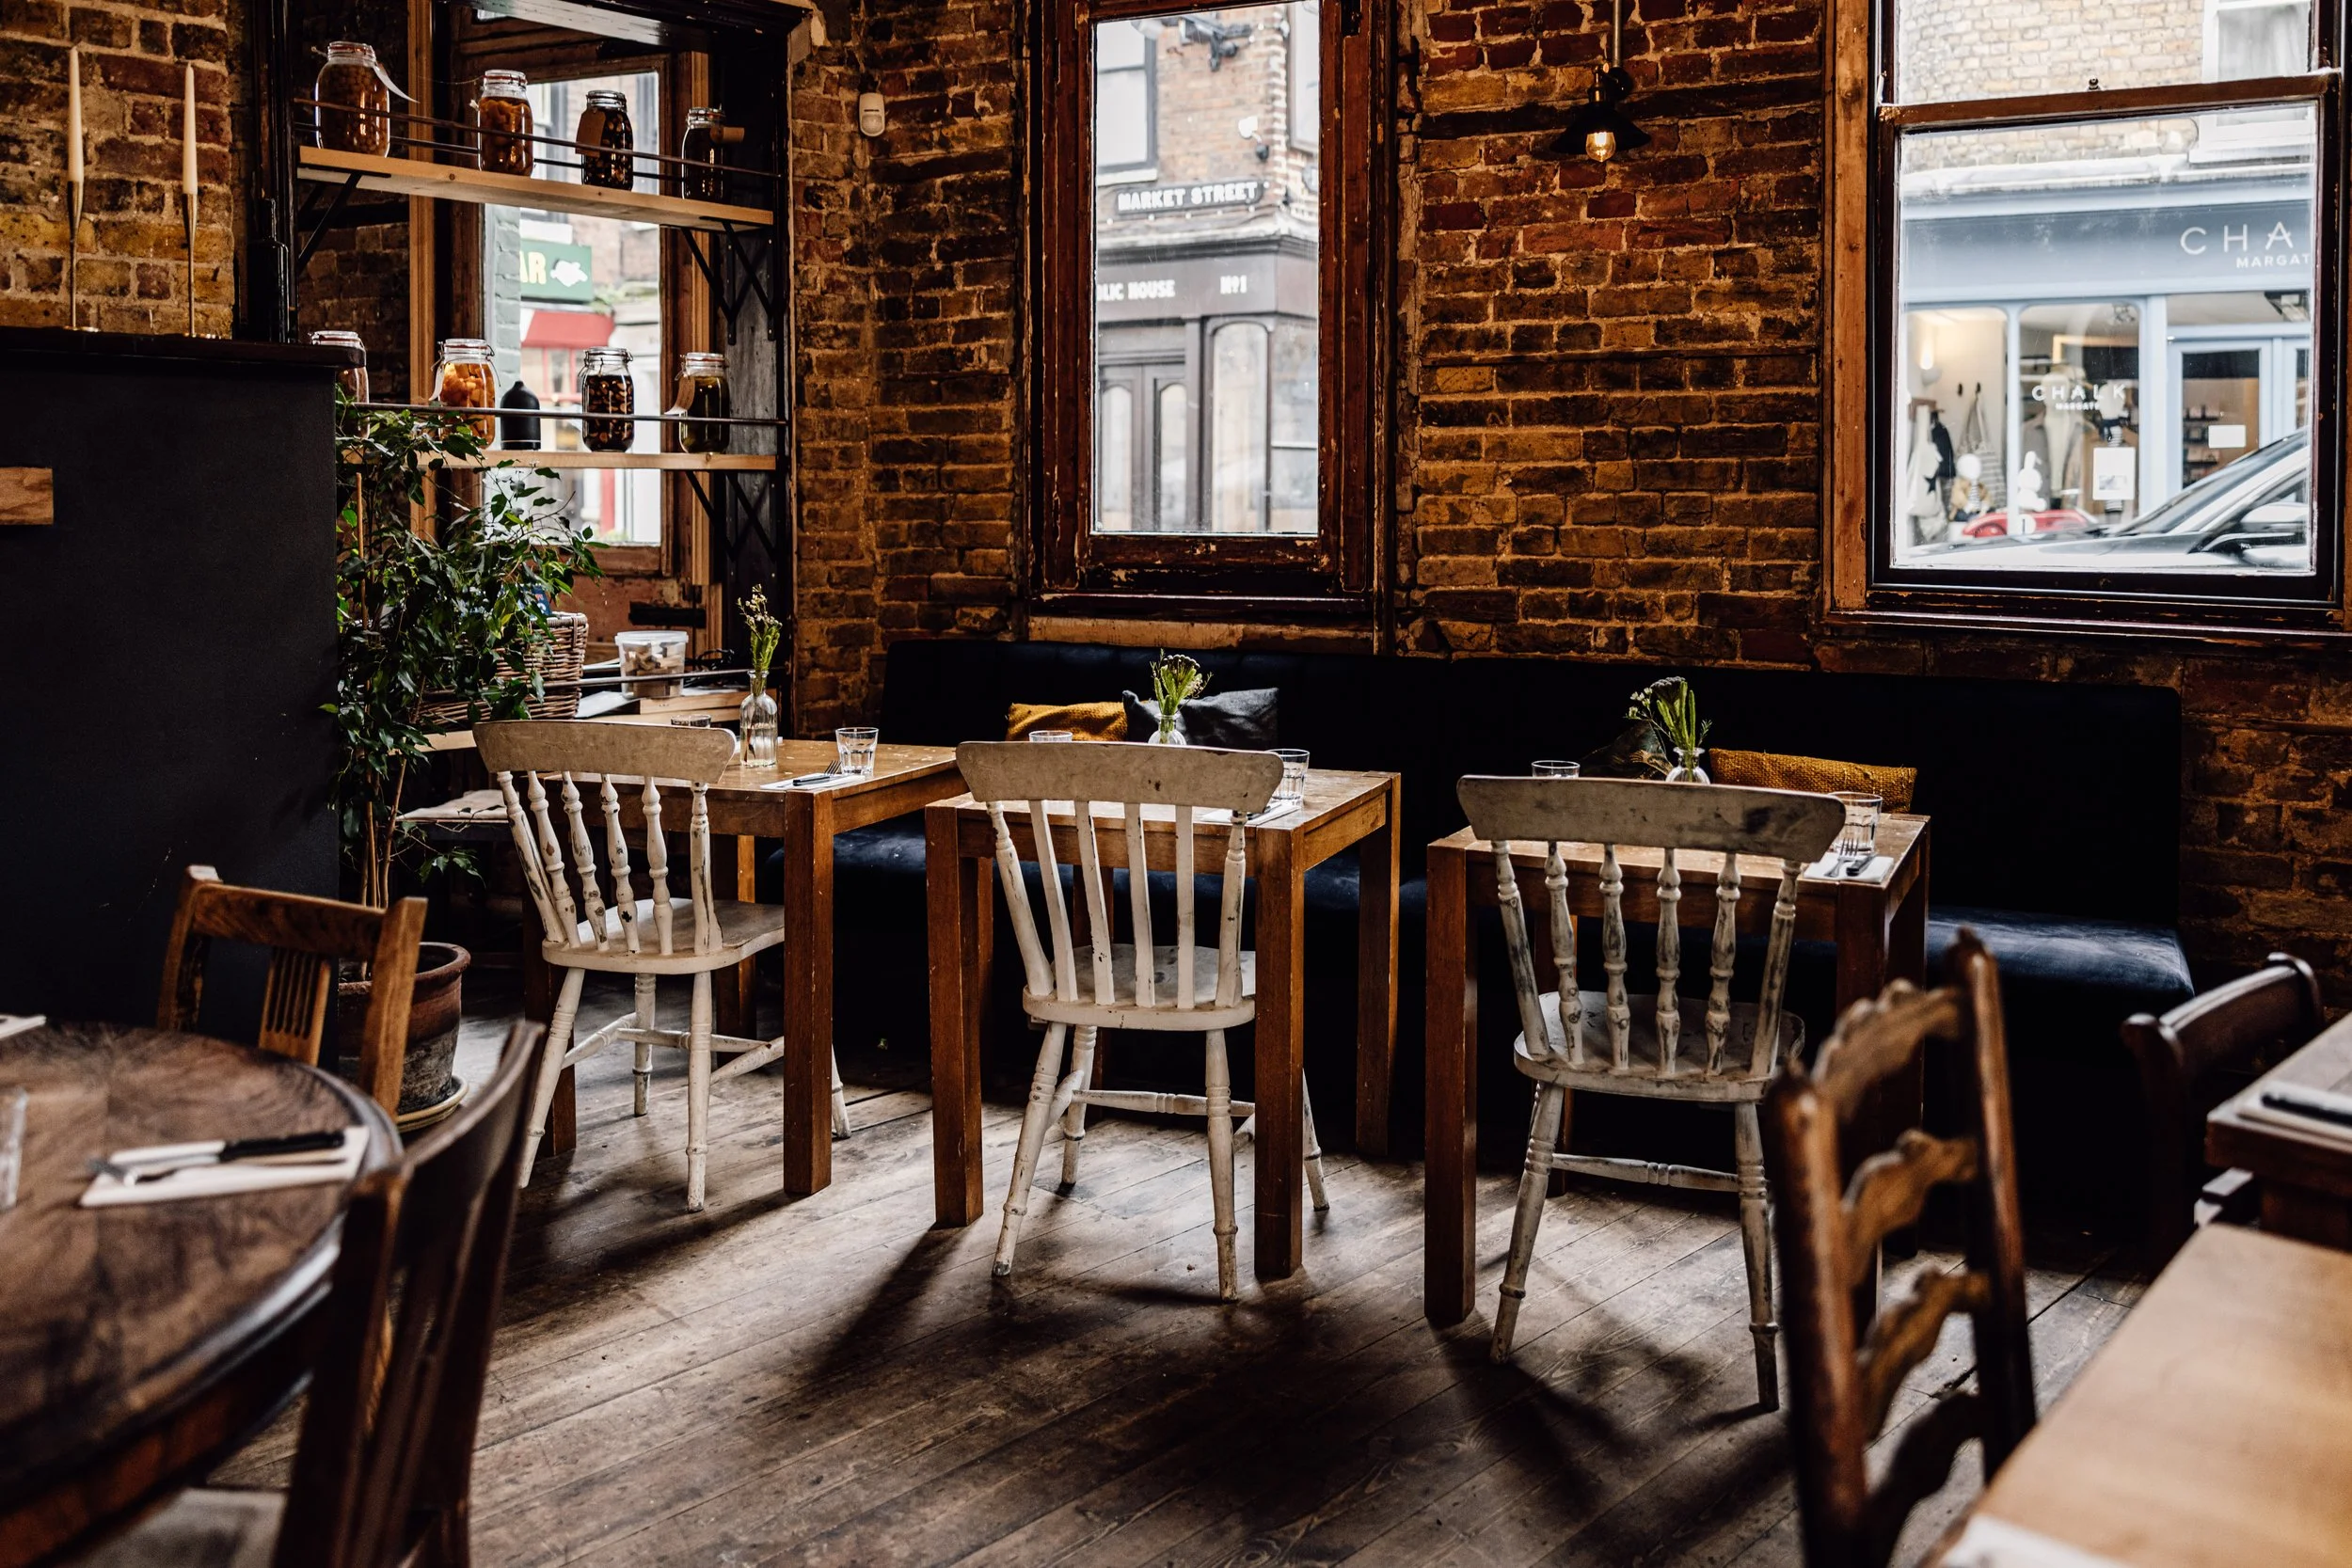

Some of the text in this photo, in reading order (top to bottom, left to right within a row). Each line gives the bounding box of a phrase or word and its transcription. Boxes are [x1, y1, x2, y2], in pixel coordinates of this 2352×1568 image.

[1118, 182, 1258, 211] MARKET STREET
[2180, 221, 2294, 255] CHA
[2236, 252, 2311, 268] MARGAT
[1128, 279, 1176, 299] HOUSE
[2032, 384, 2125, 402] CHALK
